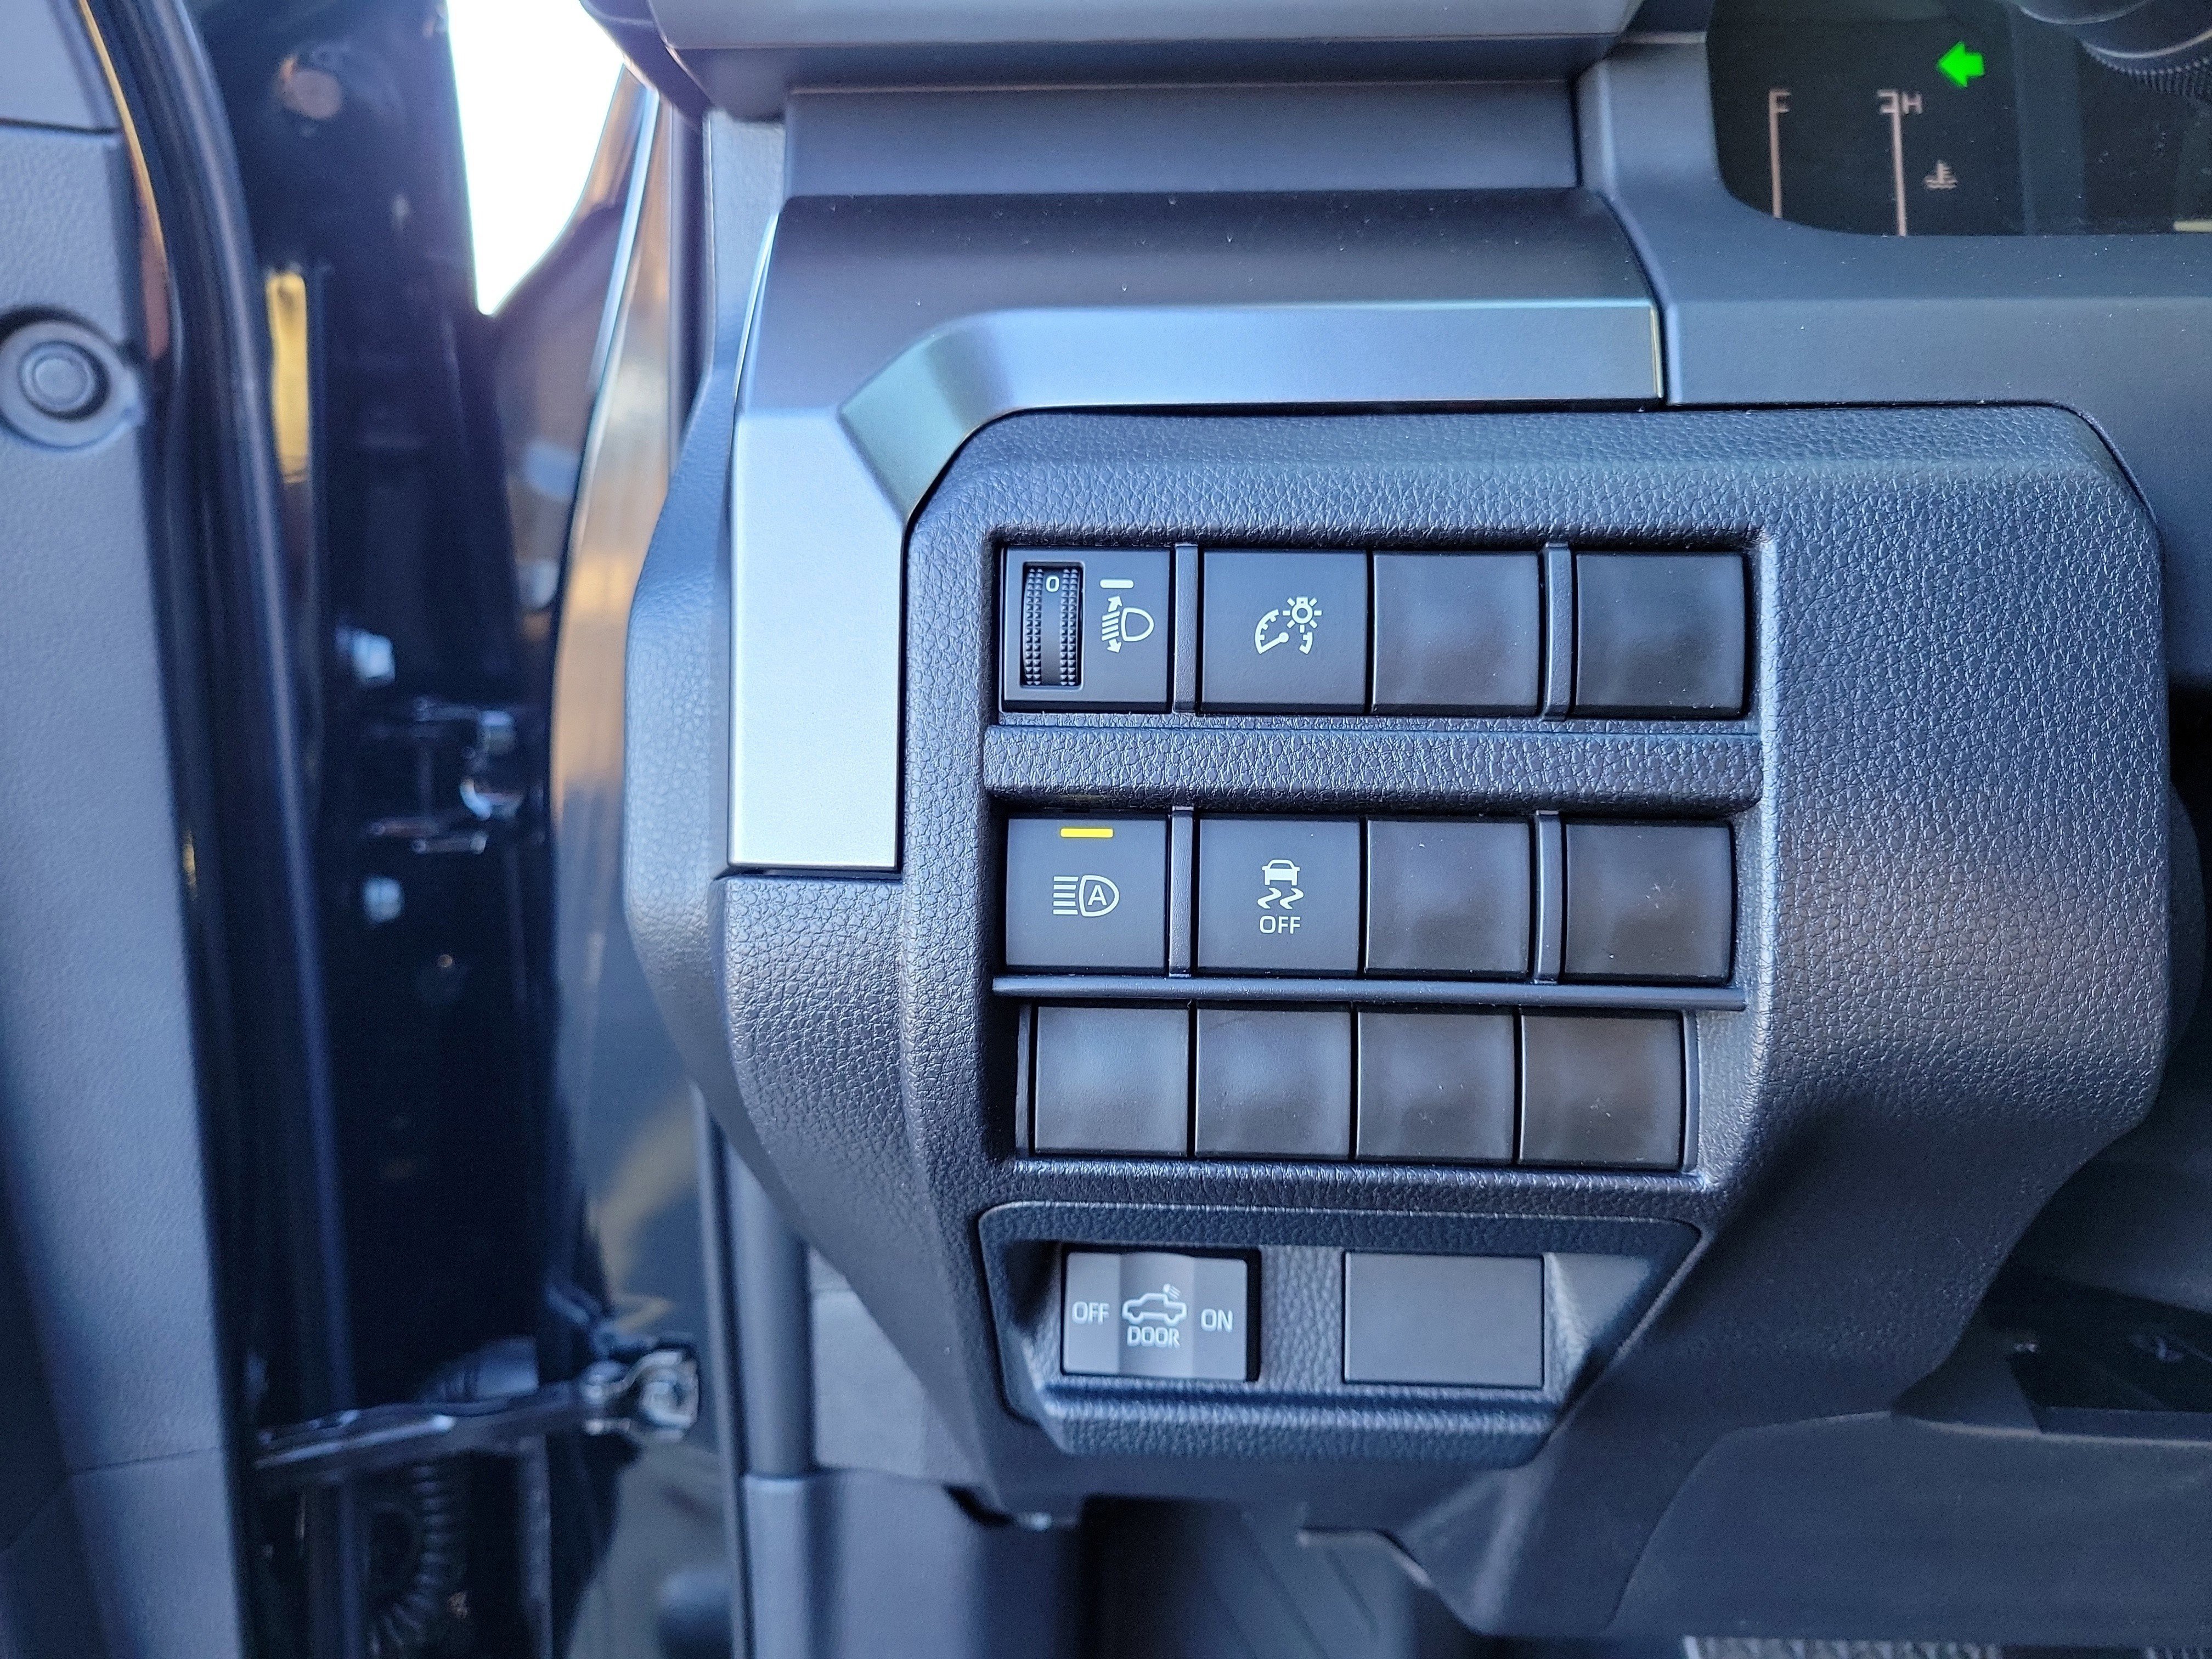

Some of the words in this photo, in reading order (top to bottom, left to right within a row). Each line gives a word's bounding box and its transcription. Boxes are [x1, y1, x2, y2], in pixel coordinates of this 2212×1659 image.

[1087, 885, 1107, 906] A
[1260, 916, 1301, 934] OFF
[1072, 1301, 1110, 1325] OFF
[1200, 1308, 1234, 1333] ON
[1126, 1326, 1181, 1349] DOOR
